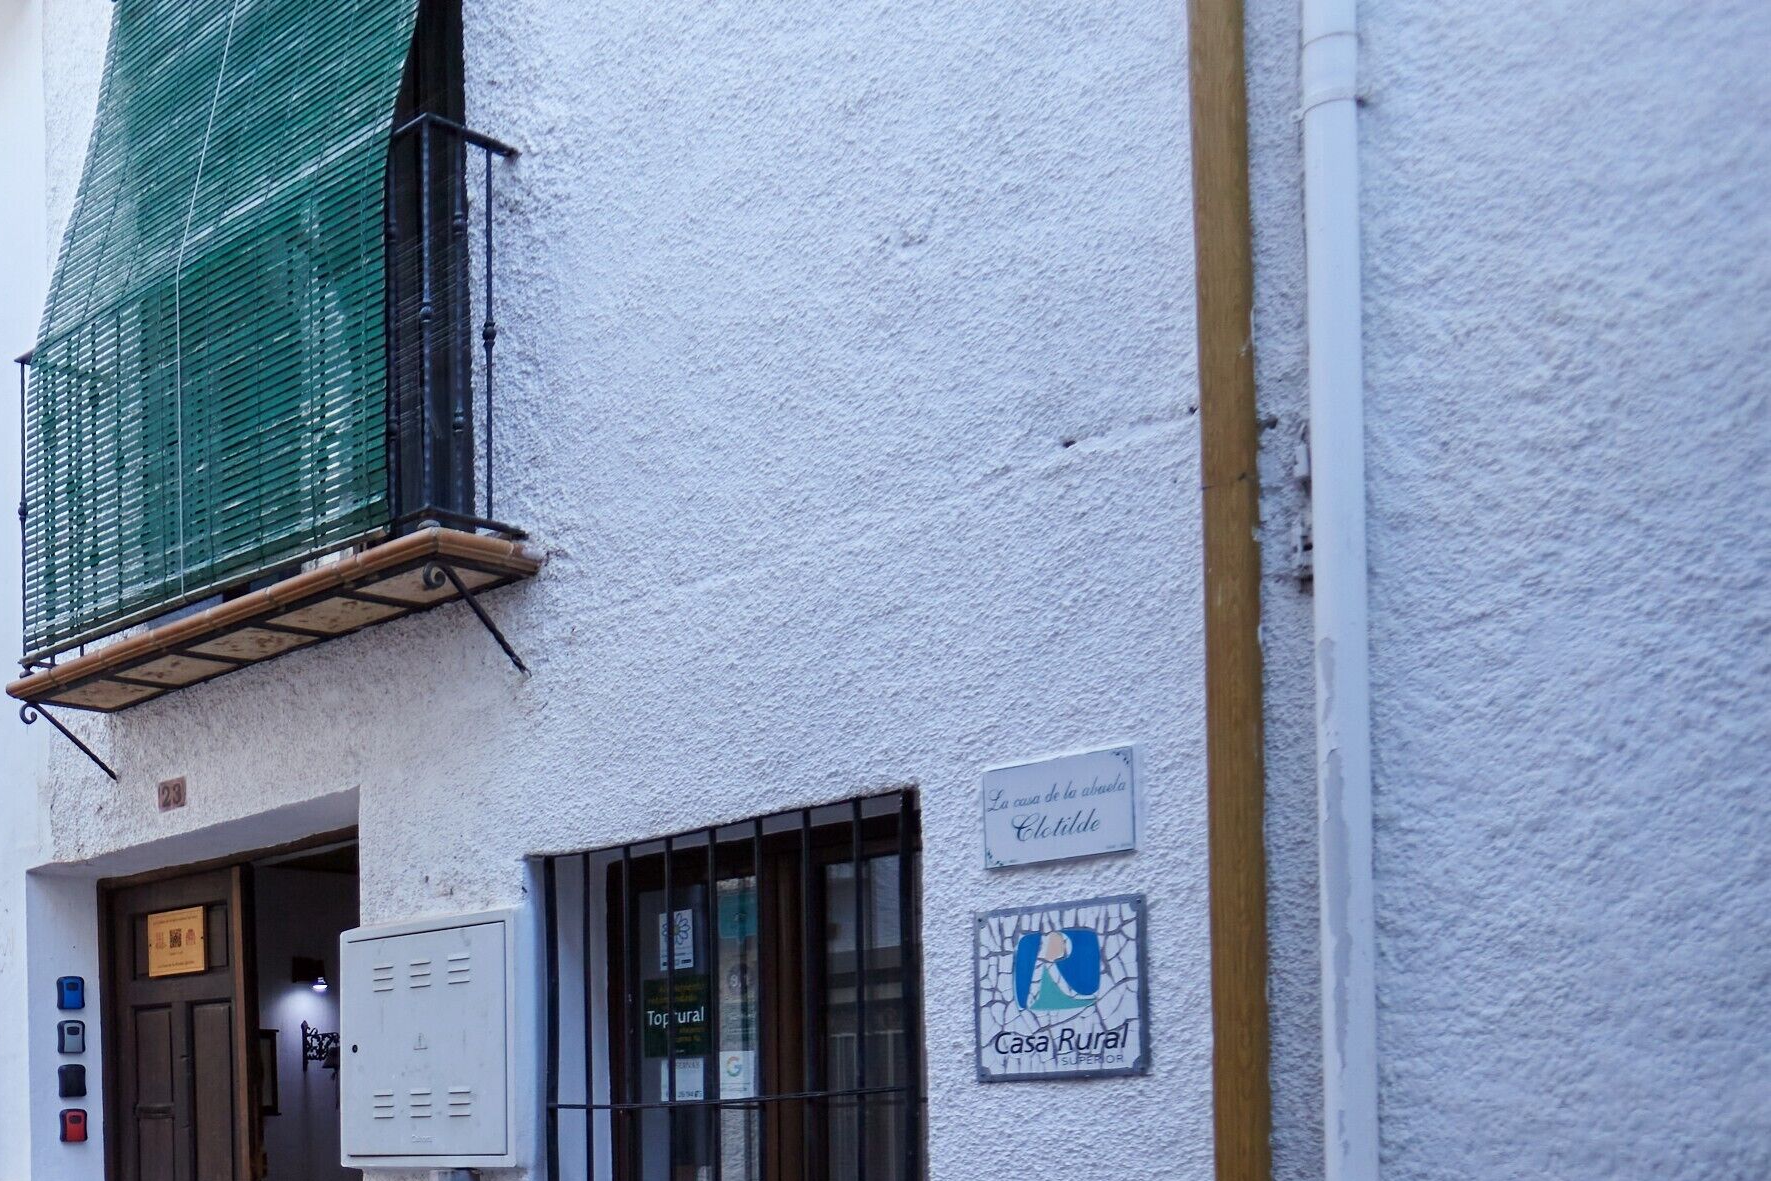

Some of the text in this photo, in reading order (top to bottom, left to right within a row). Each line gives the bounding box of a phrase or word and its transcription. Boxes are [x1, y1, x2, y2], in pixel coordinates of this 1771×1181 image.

[162, 783, 182, 808] 23
[987, 773, 1126, 813] La casa de la abuela
[1011, 808, 1101, 842] Clotilde
[995, 1022, 1130, 1055] Casa Rural
[1062, 1054, 1125, 1066] SUPERIOR
